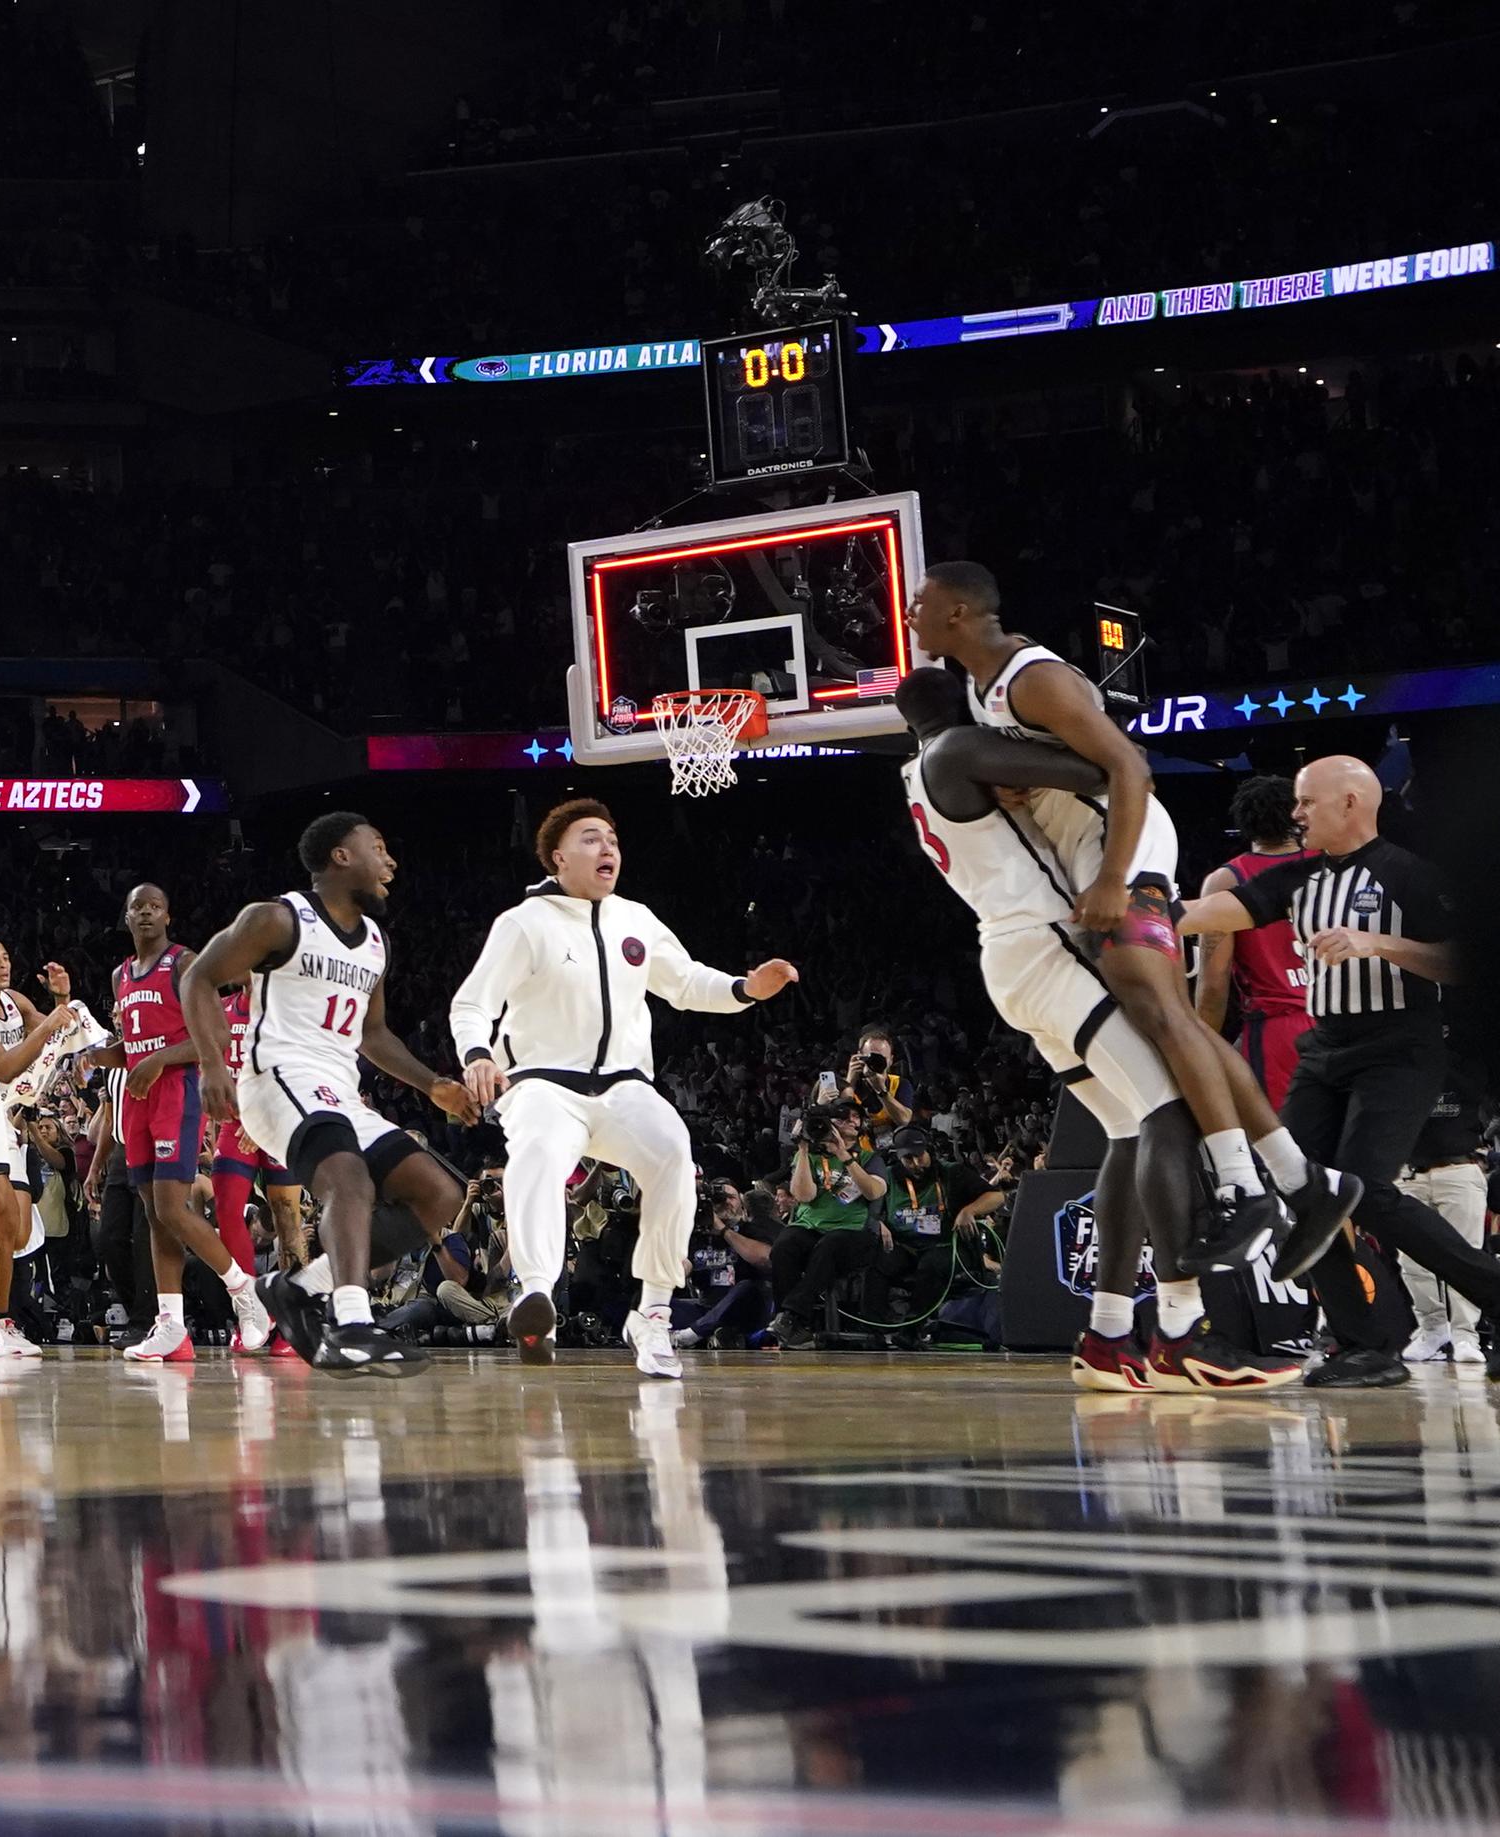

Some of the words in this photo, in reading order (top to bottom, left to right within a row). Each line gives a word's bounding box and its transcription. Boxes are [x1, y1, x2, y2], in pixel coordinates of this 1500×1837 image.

[1099, 292, 1156, 326] AND
[1162, 283, 1233, 318] THEN
[1240, 270, 1326, 309] THERE
[1331, 255, 1407, 295] WERE
[1413, 242, 1492, 282] FOUR
[528, 347, 628, 377] FLORIDA
[747, 459, 814, 477] DAKTRONICS
[7, 782, 104, 810] AZTECS
[299, 952, 324, 980] SAN
[326, 957, 358, 989] DIEGO
[357, 967, 381, 995] STAT
[120, 990, 163, 1011] FLORIDA
[130, 1009, 141, 1035] 1
[321, 994, 357, 1037] 12
